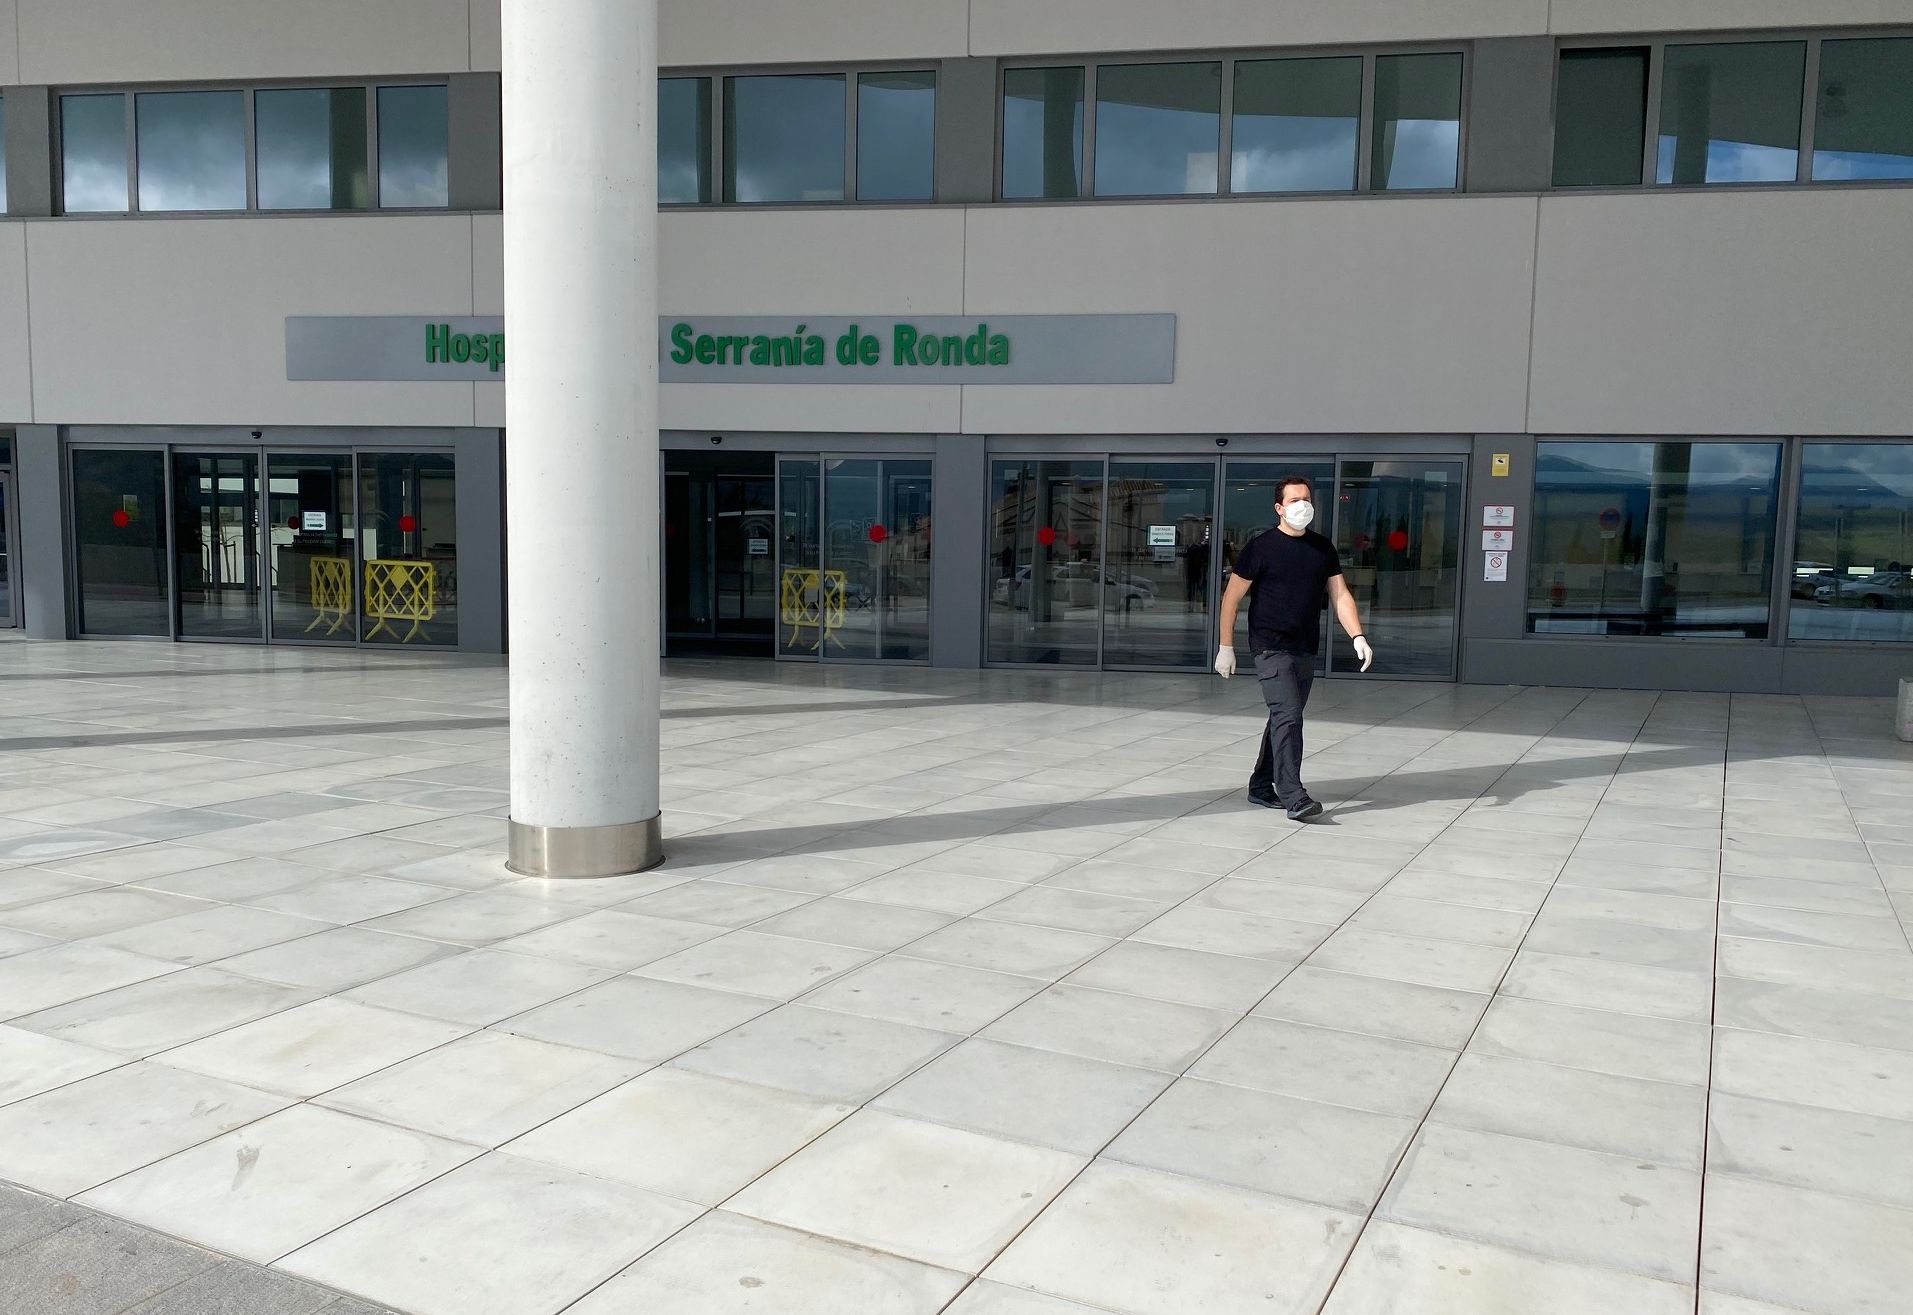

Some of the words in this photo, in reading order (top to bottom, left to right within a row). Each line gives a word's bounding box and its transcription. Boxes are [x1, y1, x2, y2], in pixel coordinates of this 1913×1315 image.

[426, 323, 505, 372] Hosp
[670, 323, 825, 367] Serranía
[836, 324, 880, 366] de
[894, 323, 1009, 366] Ronda
